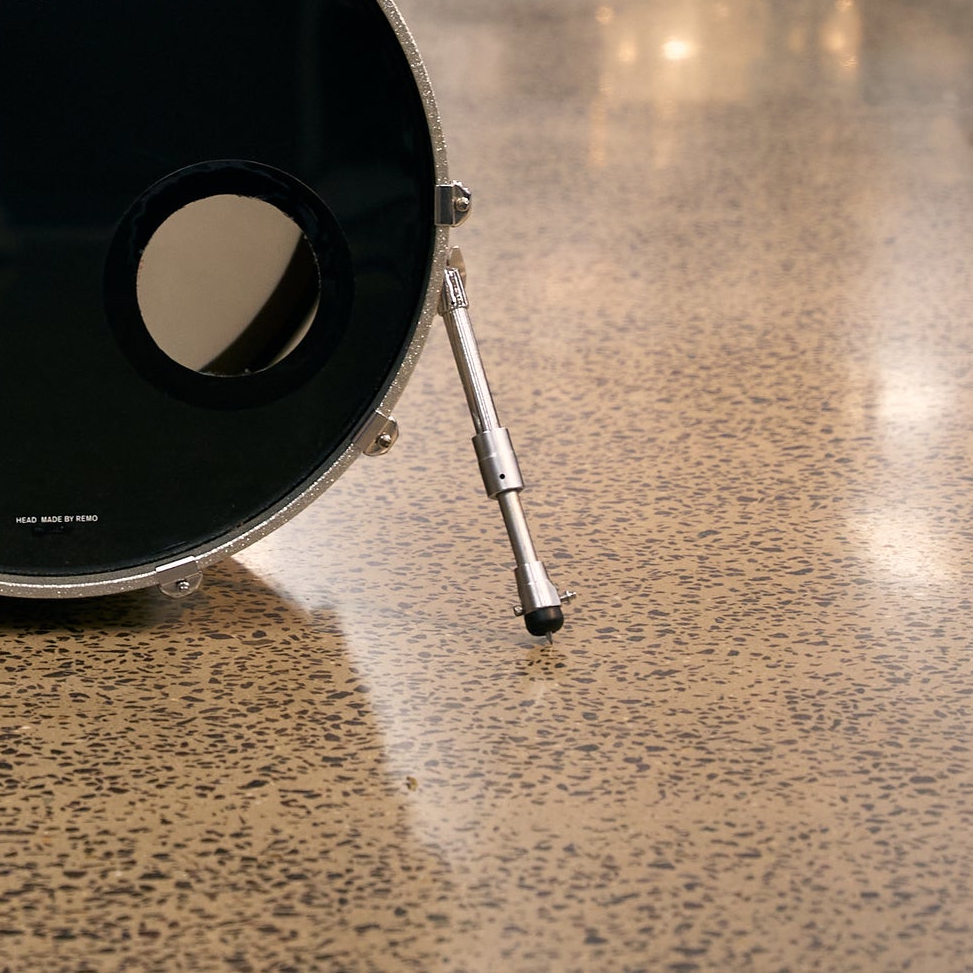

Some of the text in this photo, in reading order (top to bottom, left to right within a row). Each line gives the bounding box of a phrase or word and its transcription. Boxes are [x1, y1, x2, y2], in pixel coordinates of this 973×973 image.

[15, 514, 99, 524] HEAD MADE BY REMO
